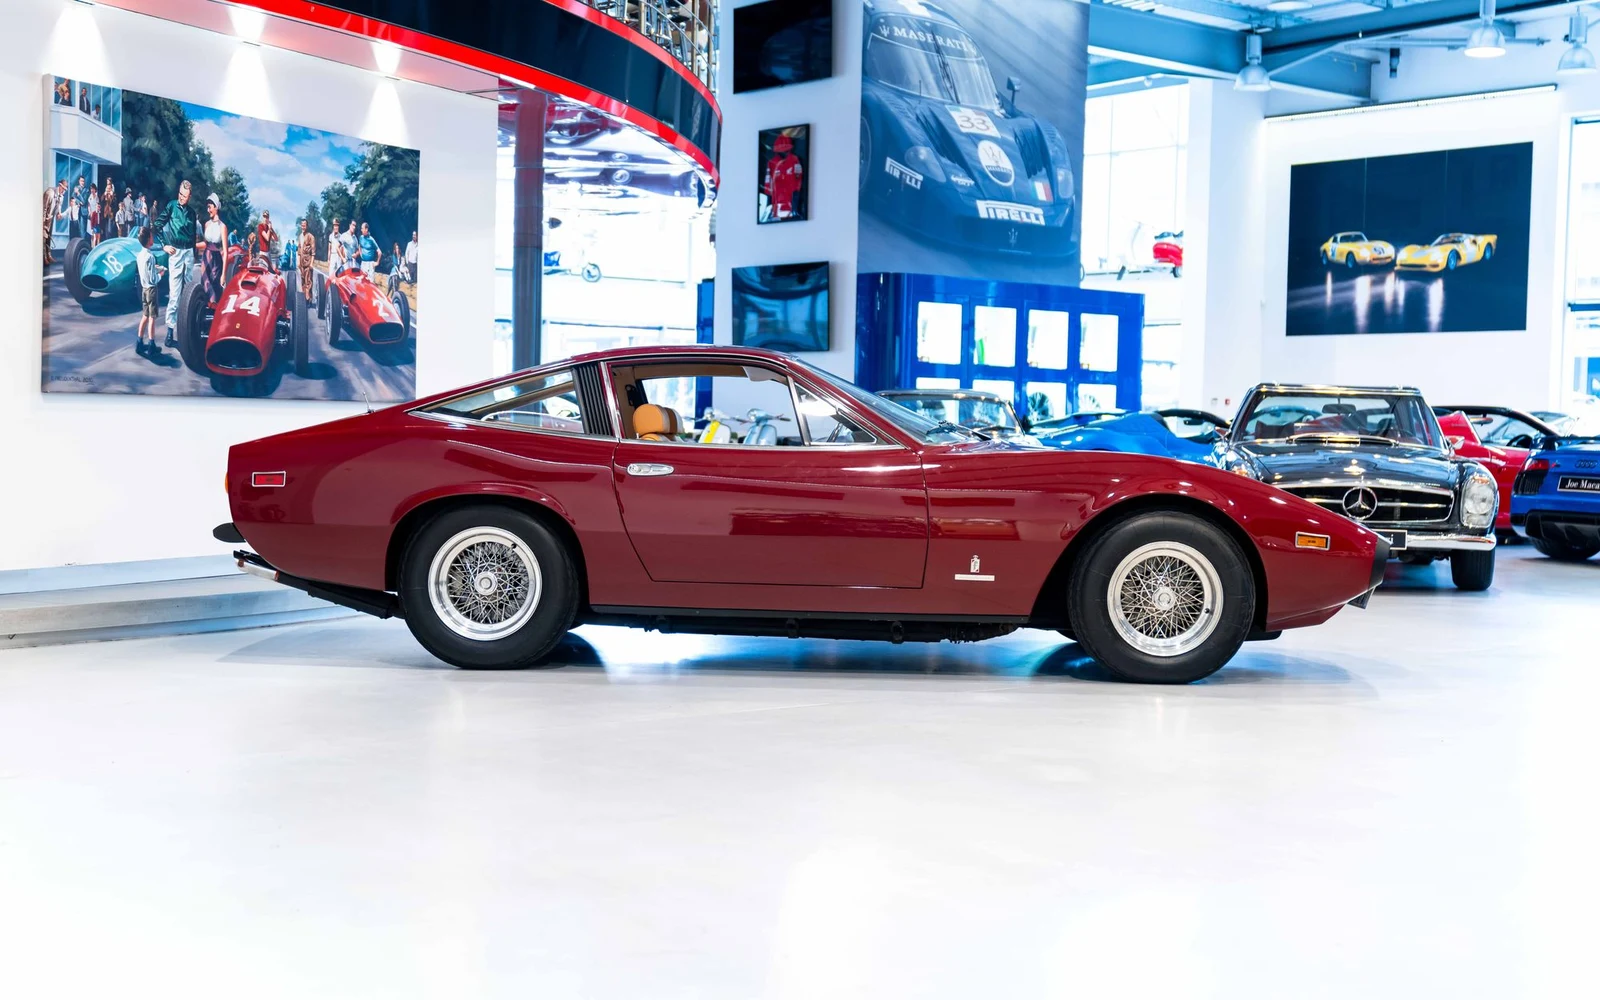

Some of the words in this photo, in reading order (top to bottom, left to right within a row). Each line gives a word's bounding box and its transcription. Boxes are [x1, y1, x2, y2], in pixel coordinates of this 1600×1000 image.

[893, 25, 968, 52] MASERATI
[958, 115, 990, 131] 33
[885, 156, 923, 190] PIRLLI
[976, 199, 1046, 226] PIRELLI
[101, 255, 124, 275] 18
[221, 294, 261, 317] 14
[1565, 478, 1579, 489] Joe
